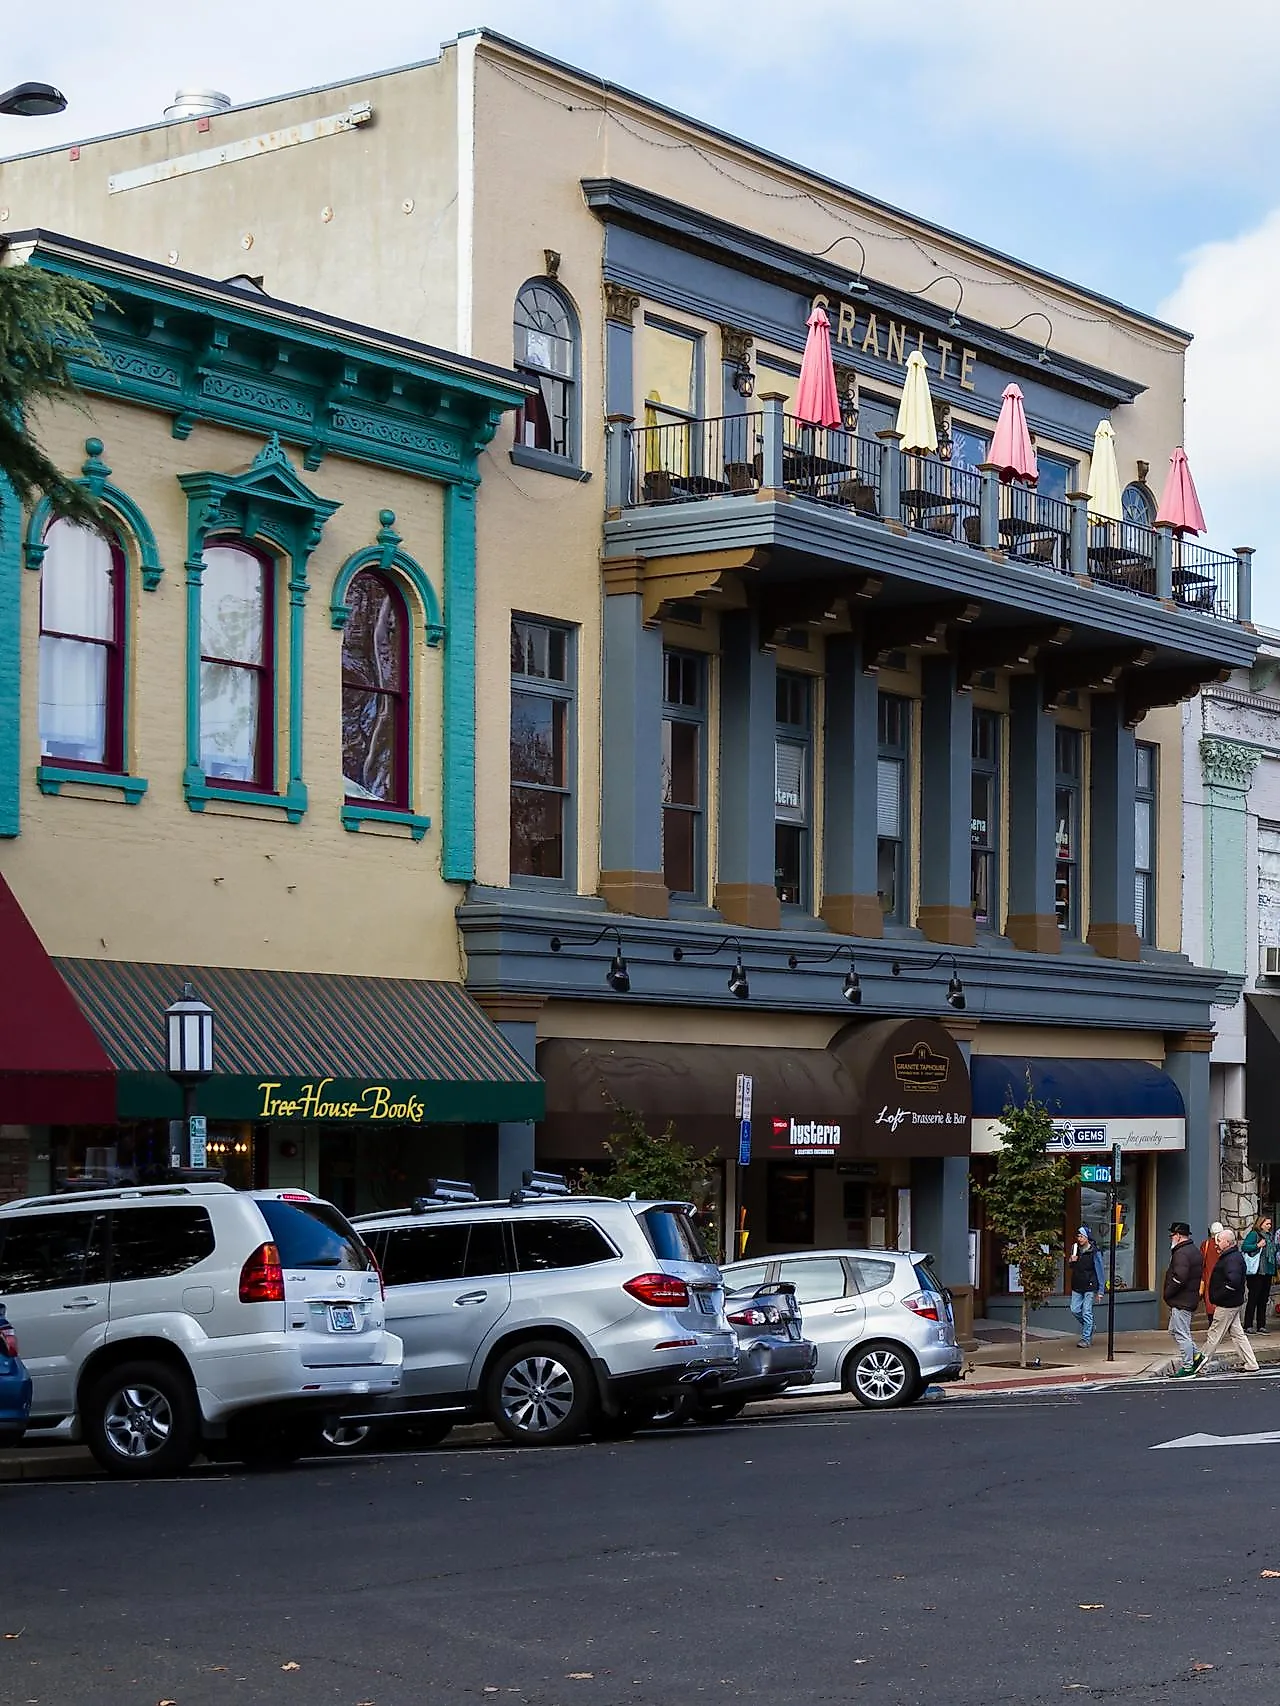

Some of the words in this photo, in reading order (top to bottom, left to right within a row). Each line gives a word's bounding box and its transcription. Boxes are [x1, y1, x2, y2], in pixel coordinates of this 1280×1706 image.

[811, 294, 977, 392] RANTE
[258, 1083, 301, 1117] Tree
[298, 1078, 365, 1119] House
[361, 1086, 425, 1123] Books
[790, 1117, 841, 1145] hysteria
[875, 1105, 911, 1132] Loft
[911, 1111, 944, 1124] Brasserie
[945, 1112, 952, 1124] &
[953, 1112, 967, 1124] Bar
[1077, 1130, 1104, 1141] GEMS
